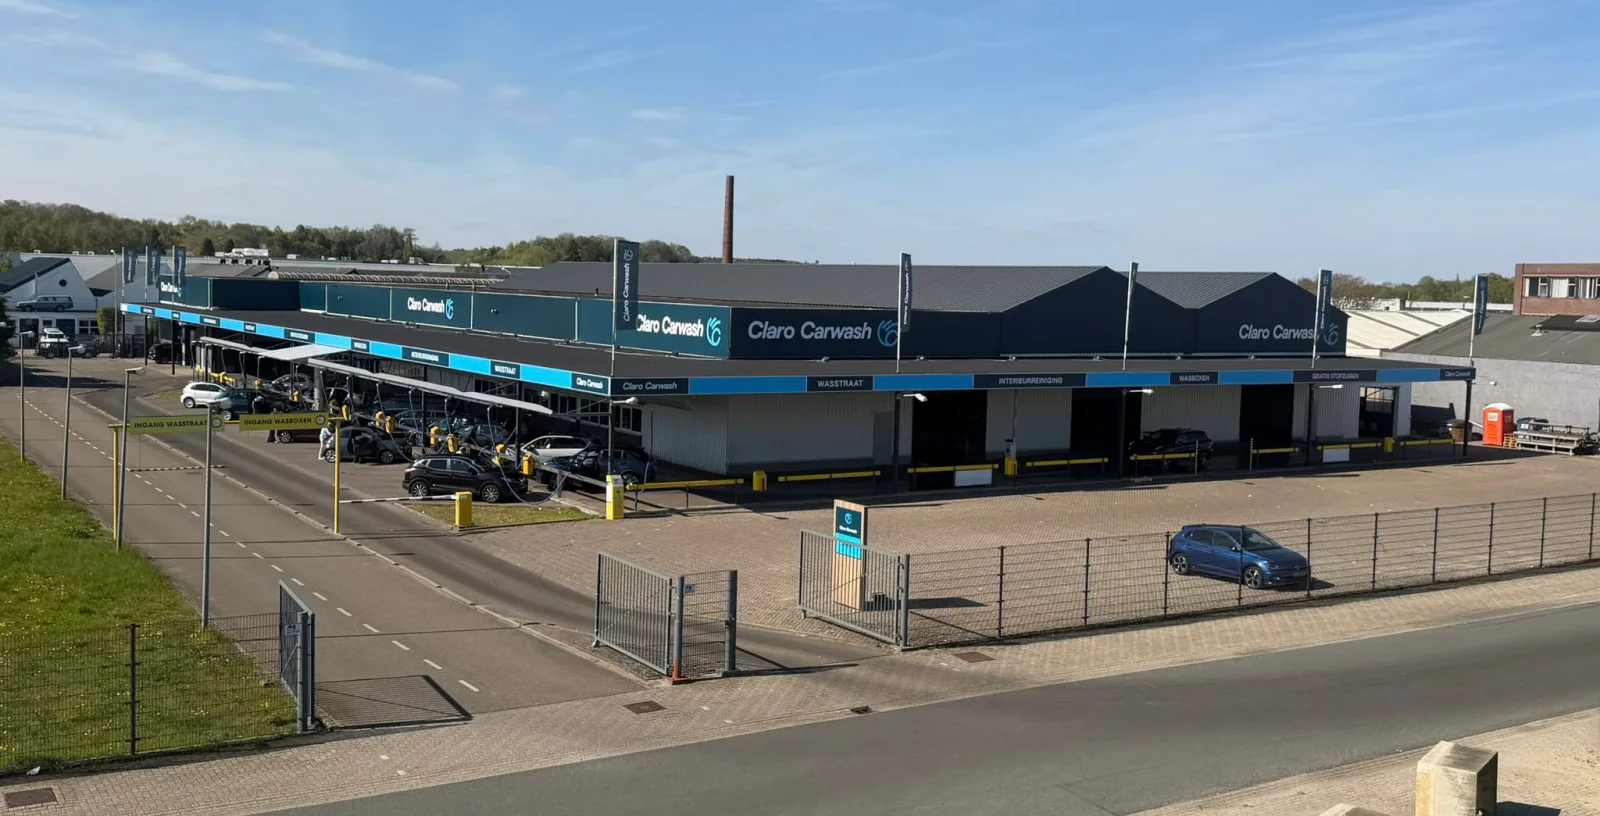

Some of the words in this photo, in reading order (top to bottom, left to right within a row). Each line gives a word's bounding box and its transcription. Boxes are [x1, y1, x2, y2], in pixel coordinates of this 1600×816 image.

[622, 263, 630, 298] Carwash
[407, 297, 421, 311] Claro
[422, 298, 445, 314] Carwash
[636, 314, 660, 333] Claro
[662, 316, 704, 337] Carwash
[748, 320, 796, 340] Claro
[800, 321, 872, 340] Carwash
[1239, 324, 1270, 340] Claro
[1273, 324, 1319, 340] Carwas
[998, 377, 1063, 385] INTERIEURREINIGING
[1178, 374, 1210, 382] WASBOXEN
[622, 382, 643, 390] Claro
[645, 381, 678, 390] Carwash
[817, 379, 864, 388] WASSTRAAT
[134, 421, 165, 429] INGANG
[166, 420, 208, 428] WASSTRAAT
[244, 418, 273, 426] INGANG
[274, 417, 312, 425] WASBOXEN
